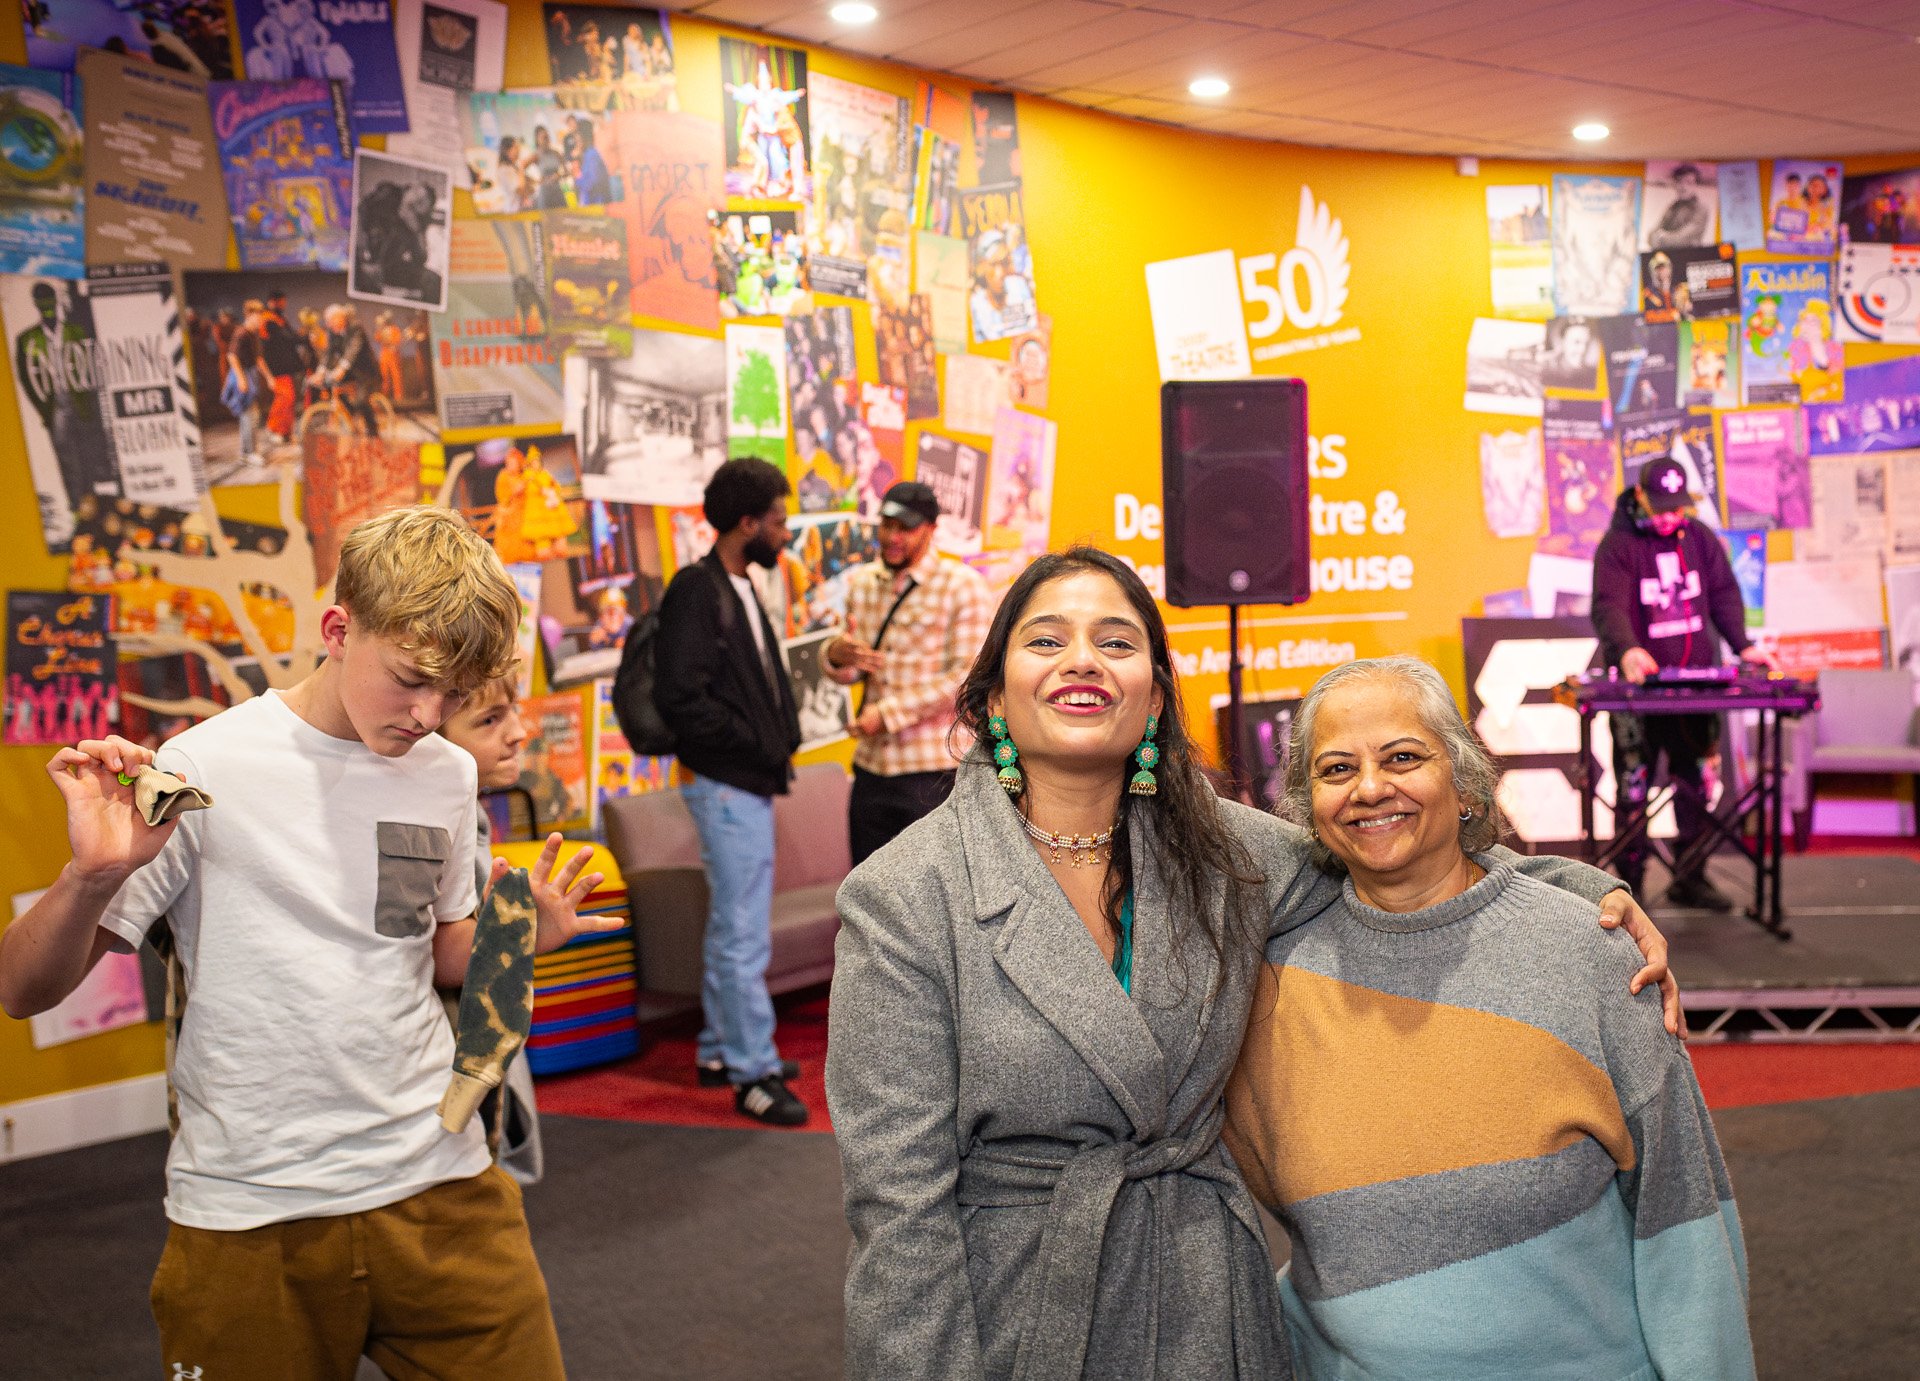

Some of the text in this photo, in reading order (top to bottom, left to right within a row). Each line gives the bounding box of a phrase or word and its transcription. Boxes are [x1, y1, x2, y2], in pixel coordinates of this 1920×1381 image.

[1239, 247, 1323, 339] 50
[1746, 264, 1827, 292] Aladdin
[122, 389, 166, 416] MR
[1372, 490, 1407, 535] &
[1279, 639, 1356, 669] Edition
